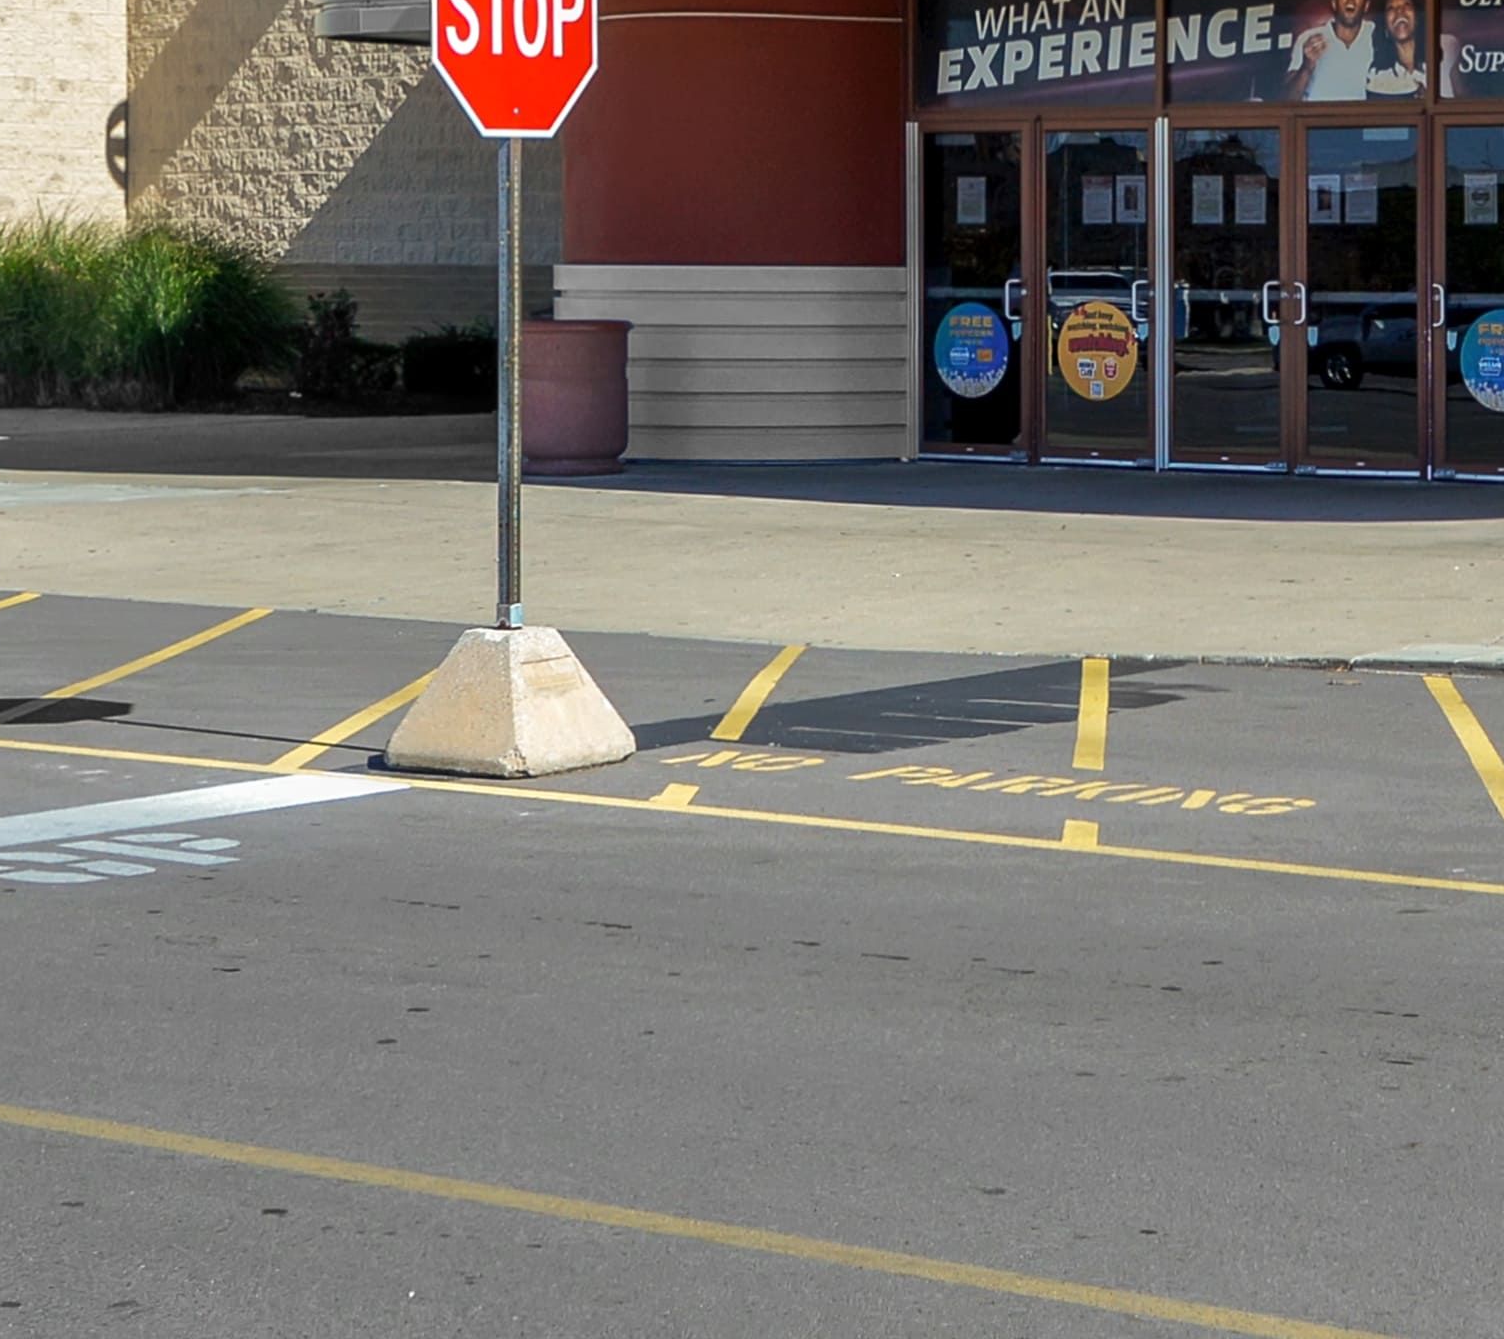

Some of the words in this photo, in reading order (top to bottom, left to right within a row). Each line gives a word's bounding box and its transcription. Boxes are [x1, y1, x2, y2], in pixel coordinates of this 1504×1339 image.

[936, 3, 1293, 94] EXPERIENCE.
[949, 316, 993, 328] FREE
[659, 750, 826, 773] NO
[848, 764, 1319, 816] PARKING
